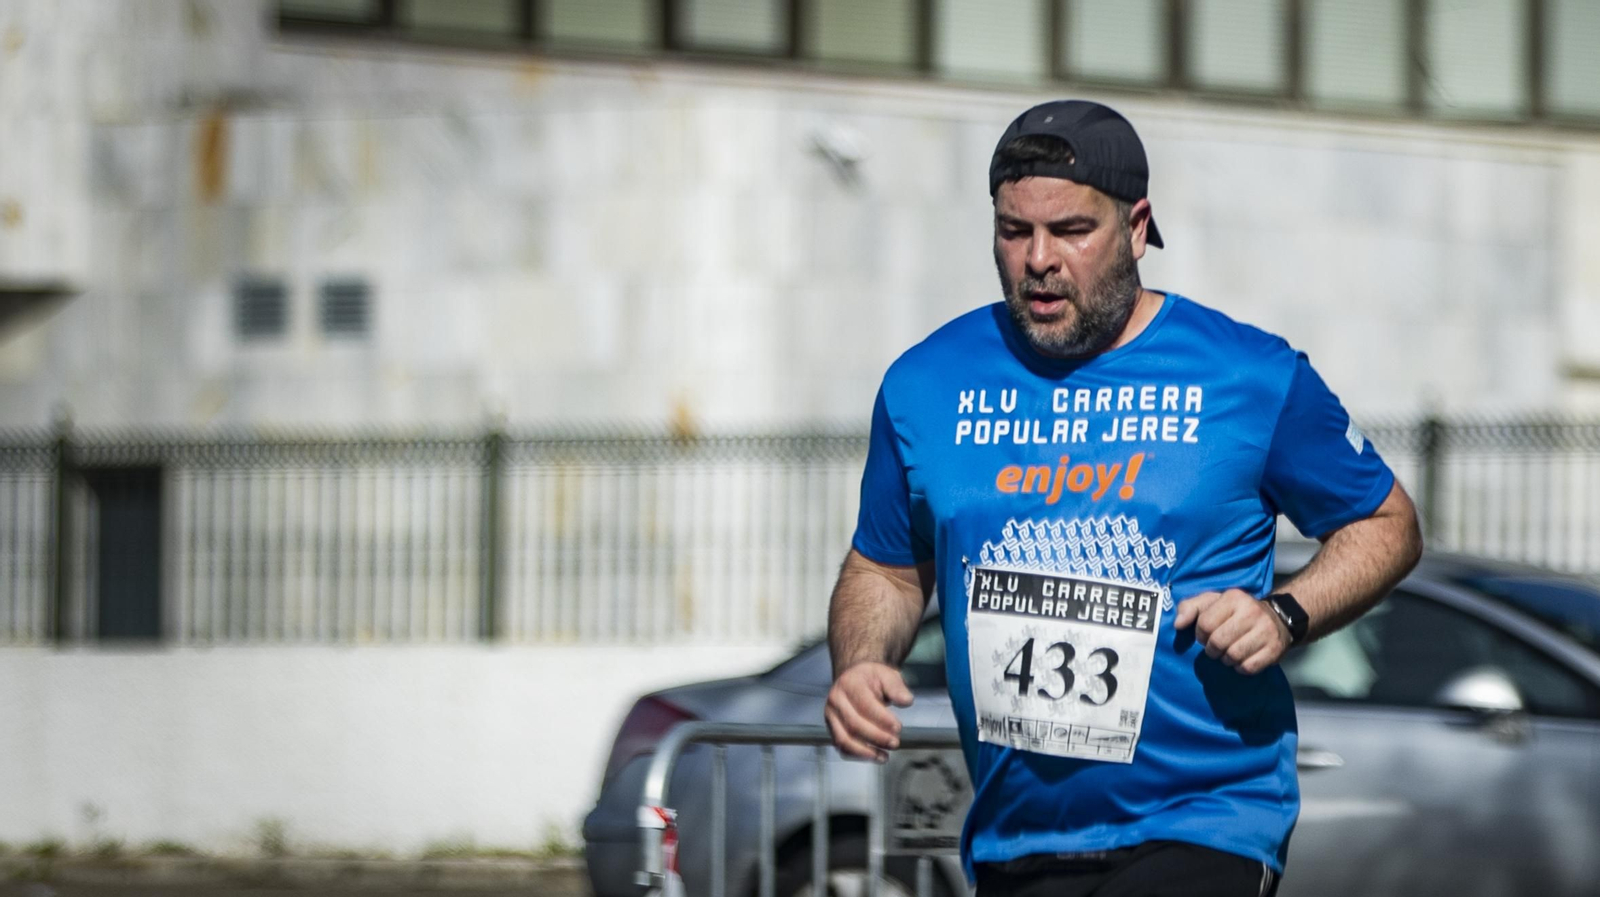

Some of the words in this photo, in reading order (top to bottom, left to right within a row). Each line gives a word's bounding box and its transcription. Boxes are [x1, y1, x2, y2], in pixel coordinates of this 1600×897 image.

[958, 389, 1017, 414] XLV
[1053, 386, 1203, 414] CARRERA
[955, 419, 1088, 445] POPULAR
[1101, 418, 1200, 444] JEREZ
[996, 452, 1145, 505] enjoy!
[978, 593, 1069, 618] POPULAR
[1077, 603, 1148, 629] JEREZ
[1042, 579, 1152, 612] CARRERA
[1003, 637, 1120, 706] 433
